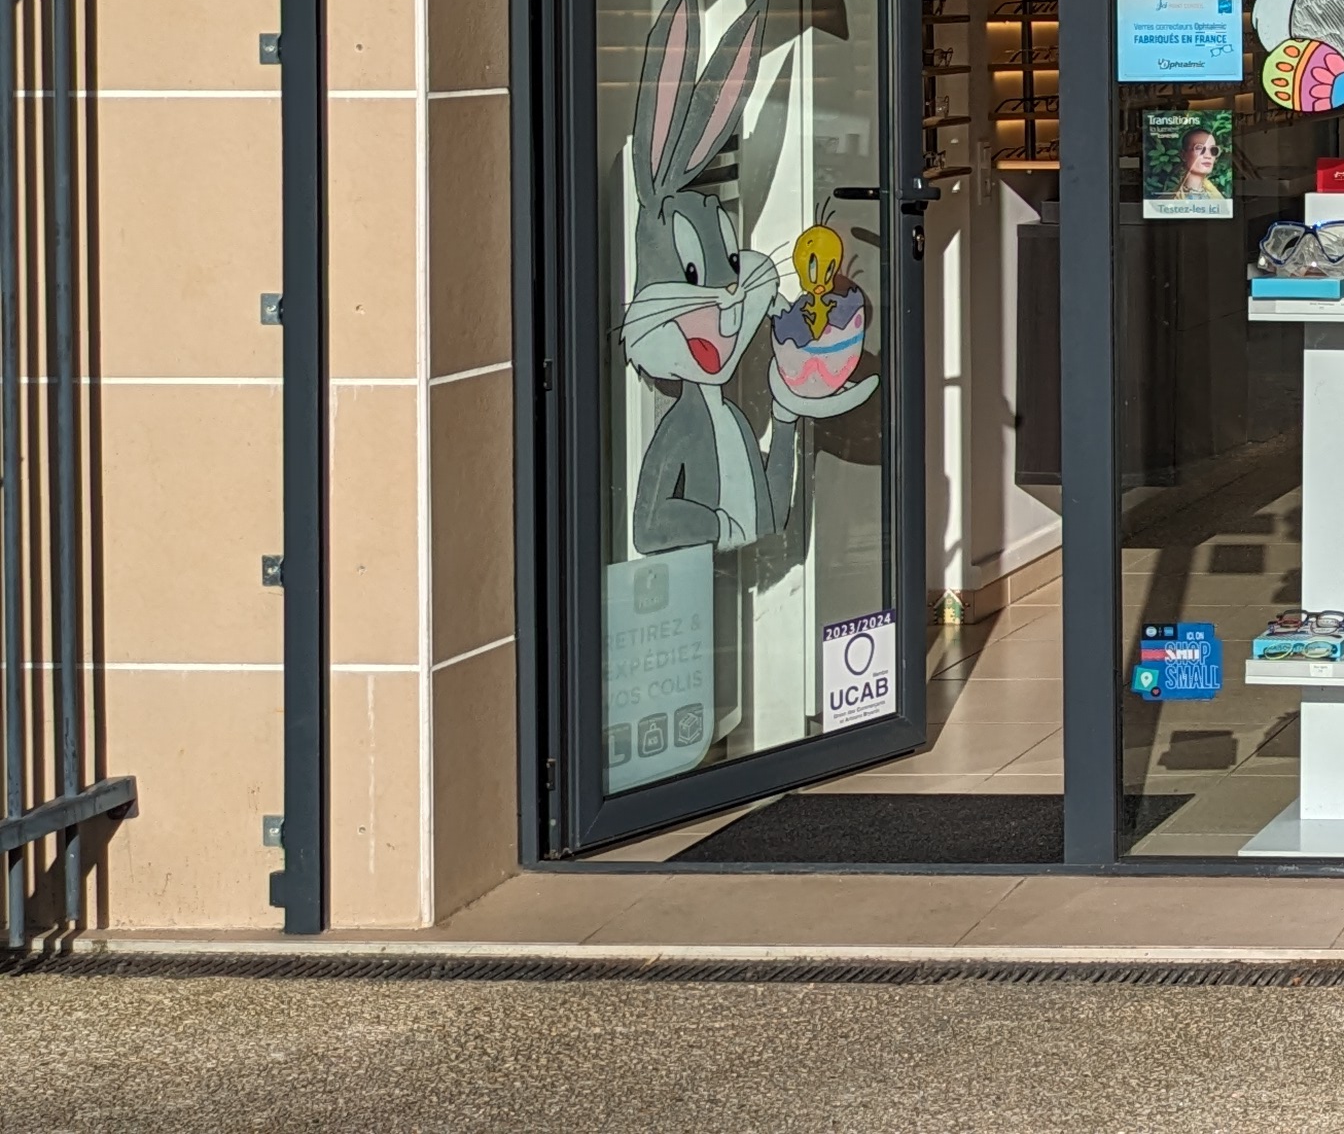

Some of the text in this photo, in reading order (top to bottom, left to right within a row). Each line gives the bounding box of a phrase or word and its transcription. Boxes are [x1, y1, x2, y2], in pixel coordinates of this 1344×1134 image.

[1134, 33, 1227, 44] FABRIQUÉS EN FRANCE
[1147, 114, 1200, 126] Transitions
[1158, 204, 1220, 214] Testez-les ici
[825, 612, 892, 640] 2023/2024
[1164, 641, 1211, 666] SHOP
[1165, 665, 1221, 690] SMALL
[830, 676, 889, 711] UCAB
